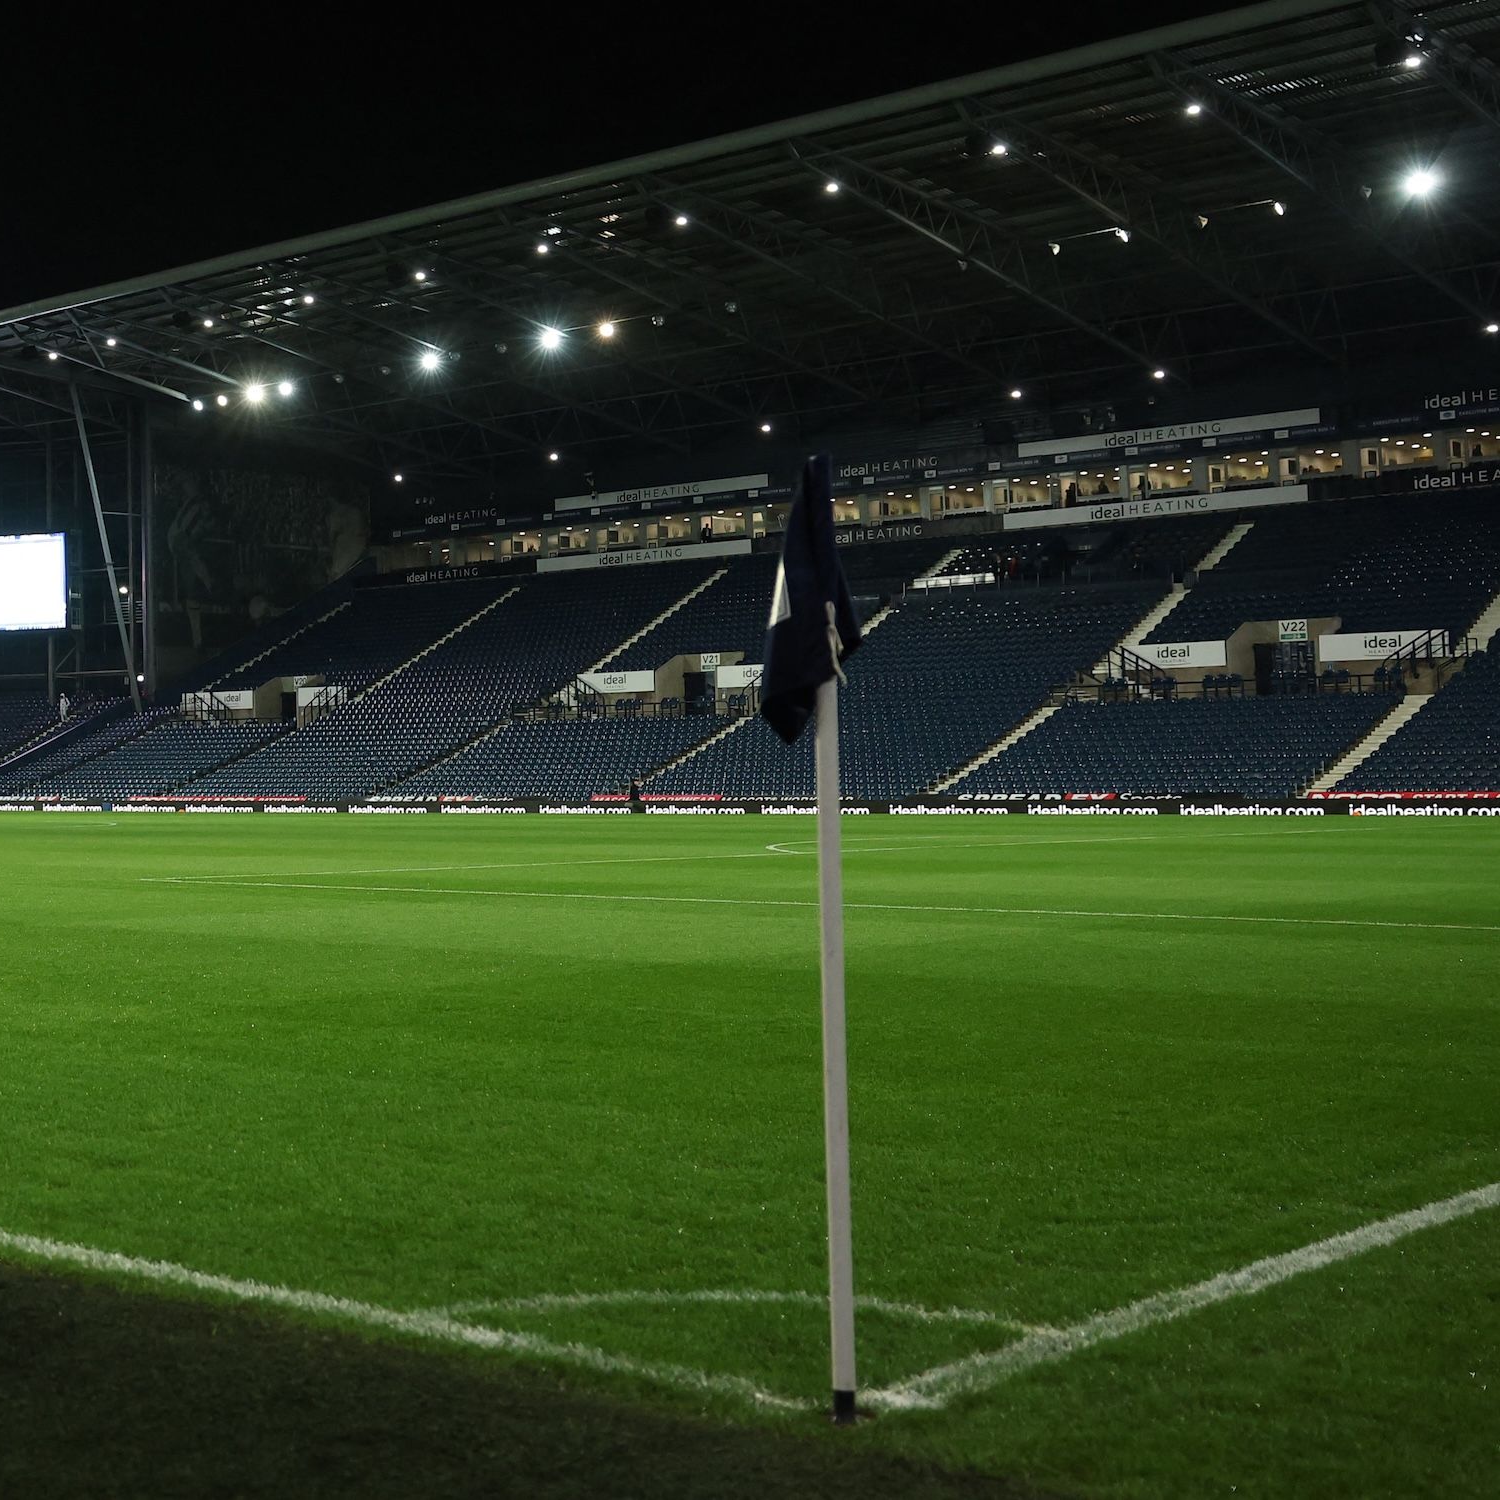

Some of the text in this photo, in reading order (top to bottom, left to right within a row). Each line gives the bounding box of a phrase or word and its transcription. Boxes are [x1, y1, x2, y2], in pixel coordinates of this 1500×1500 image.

[1425, 391, 1466, 409] ideal
[1104, 431, 1138, 447] ideal
[1143, 423, 1221, 441] HEATING
[839, 463, 869, 478] ideal
[871, 456, 939, 473] HEATING
[1414, 471, 1456, 490] ideal
[616, 490, 641, 503] ideal
[642, 483, 700, 499] HEATING
[1090, 497, 1209, 520] ideal HEATING
[424, 511, 447, 525] ideal
[448, 507, 497, 522] HEATING
[835, 525, 923, 544] eal HEATING
[599, 548, 682, 566] ideal HEATING
[406, 566, 479, 583] ideal HEATING
[1281, 621, 1306, 632] V22
[1364, 634, 1402, 649] ideal
[1157, 645, 1190, 659] ideal
[702, 655, 718, 664] V21
[742, 668, 764, 678] idea
[603, 674, 627, 685] ideal
[223, 693, 241, 703] ideal
[42, 803, 102, 812] idealheatingcom
[112, 803, 175, 812] idealheatingcom
[185, 803, 253, 812] idealheatingcom
[263, 804, 337, 813] idealheatingcom
[348, 804, 427, 813] idealheatingcom
[440, 804, 526, 814] idealheatingcom
[539, 804, 631, 814] idealheatingcom
[645, 804, 745, 814] idealheatingcom
[761, 804, 870, 815] idealheaticom
[889, 804, 1008, 815] idealheatingcom
[1027, 804, 1158, 815] idealheatingcom
[1180, 804, 1324, 816] idealheatingcom
[1348, 804, 1500, 816] idealheatingcom
